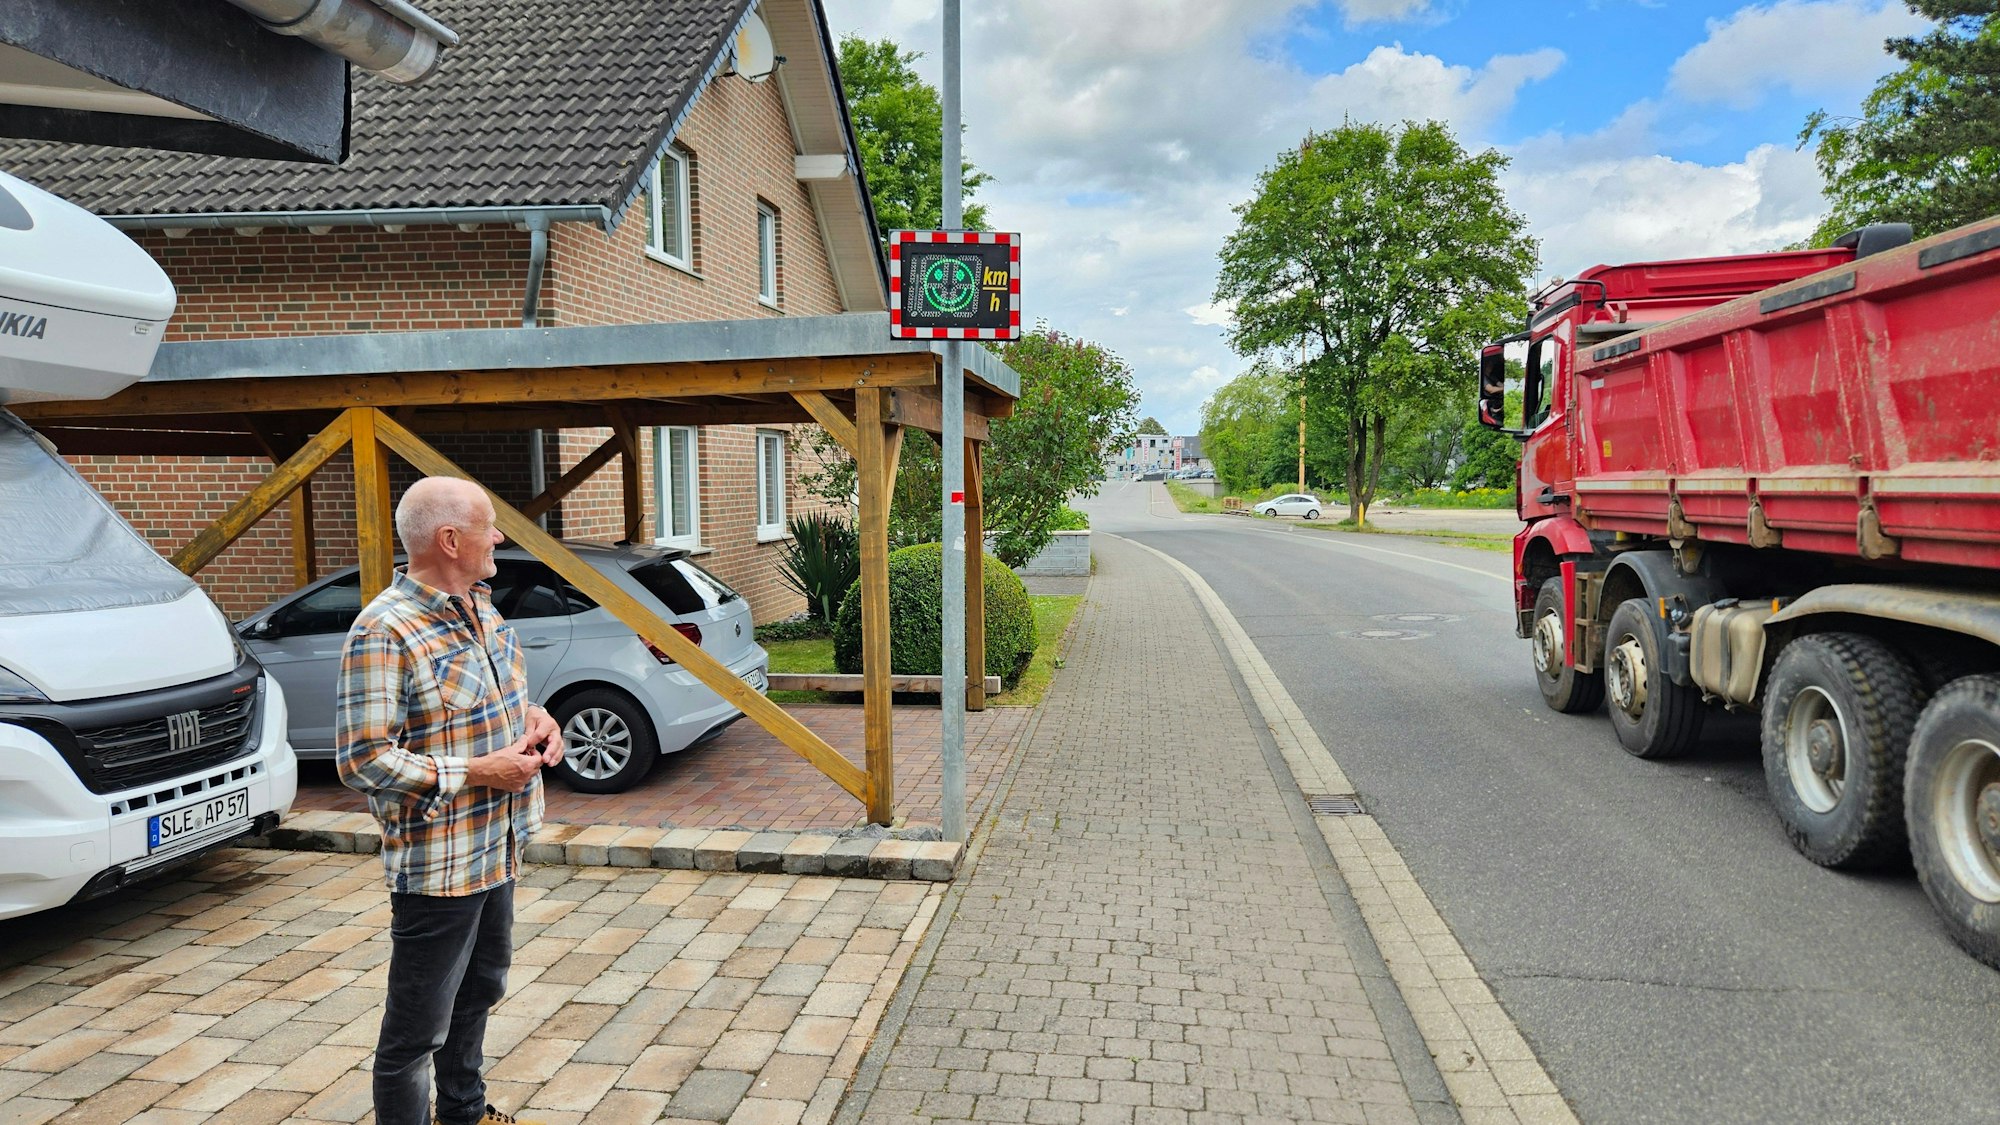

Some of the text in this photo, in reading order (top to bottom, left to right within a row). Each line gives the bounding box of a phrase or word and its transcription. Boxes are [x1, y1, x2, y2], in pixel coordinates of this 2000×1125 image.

[982, 266, 1008, 286] km
[989, 292, 1001, 312] h
[166, 710, 200, 751] FIAT
[161, 793, 245, 839] SLE AP 57
[152, 834, 157, 842] D
